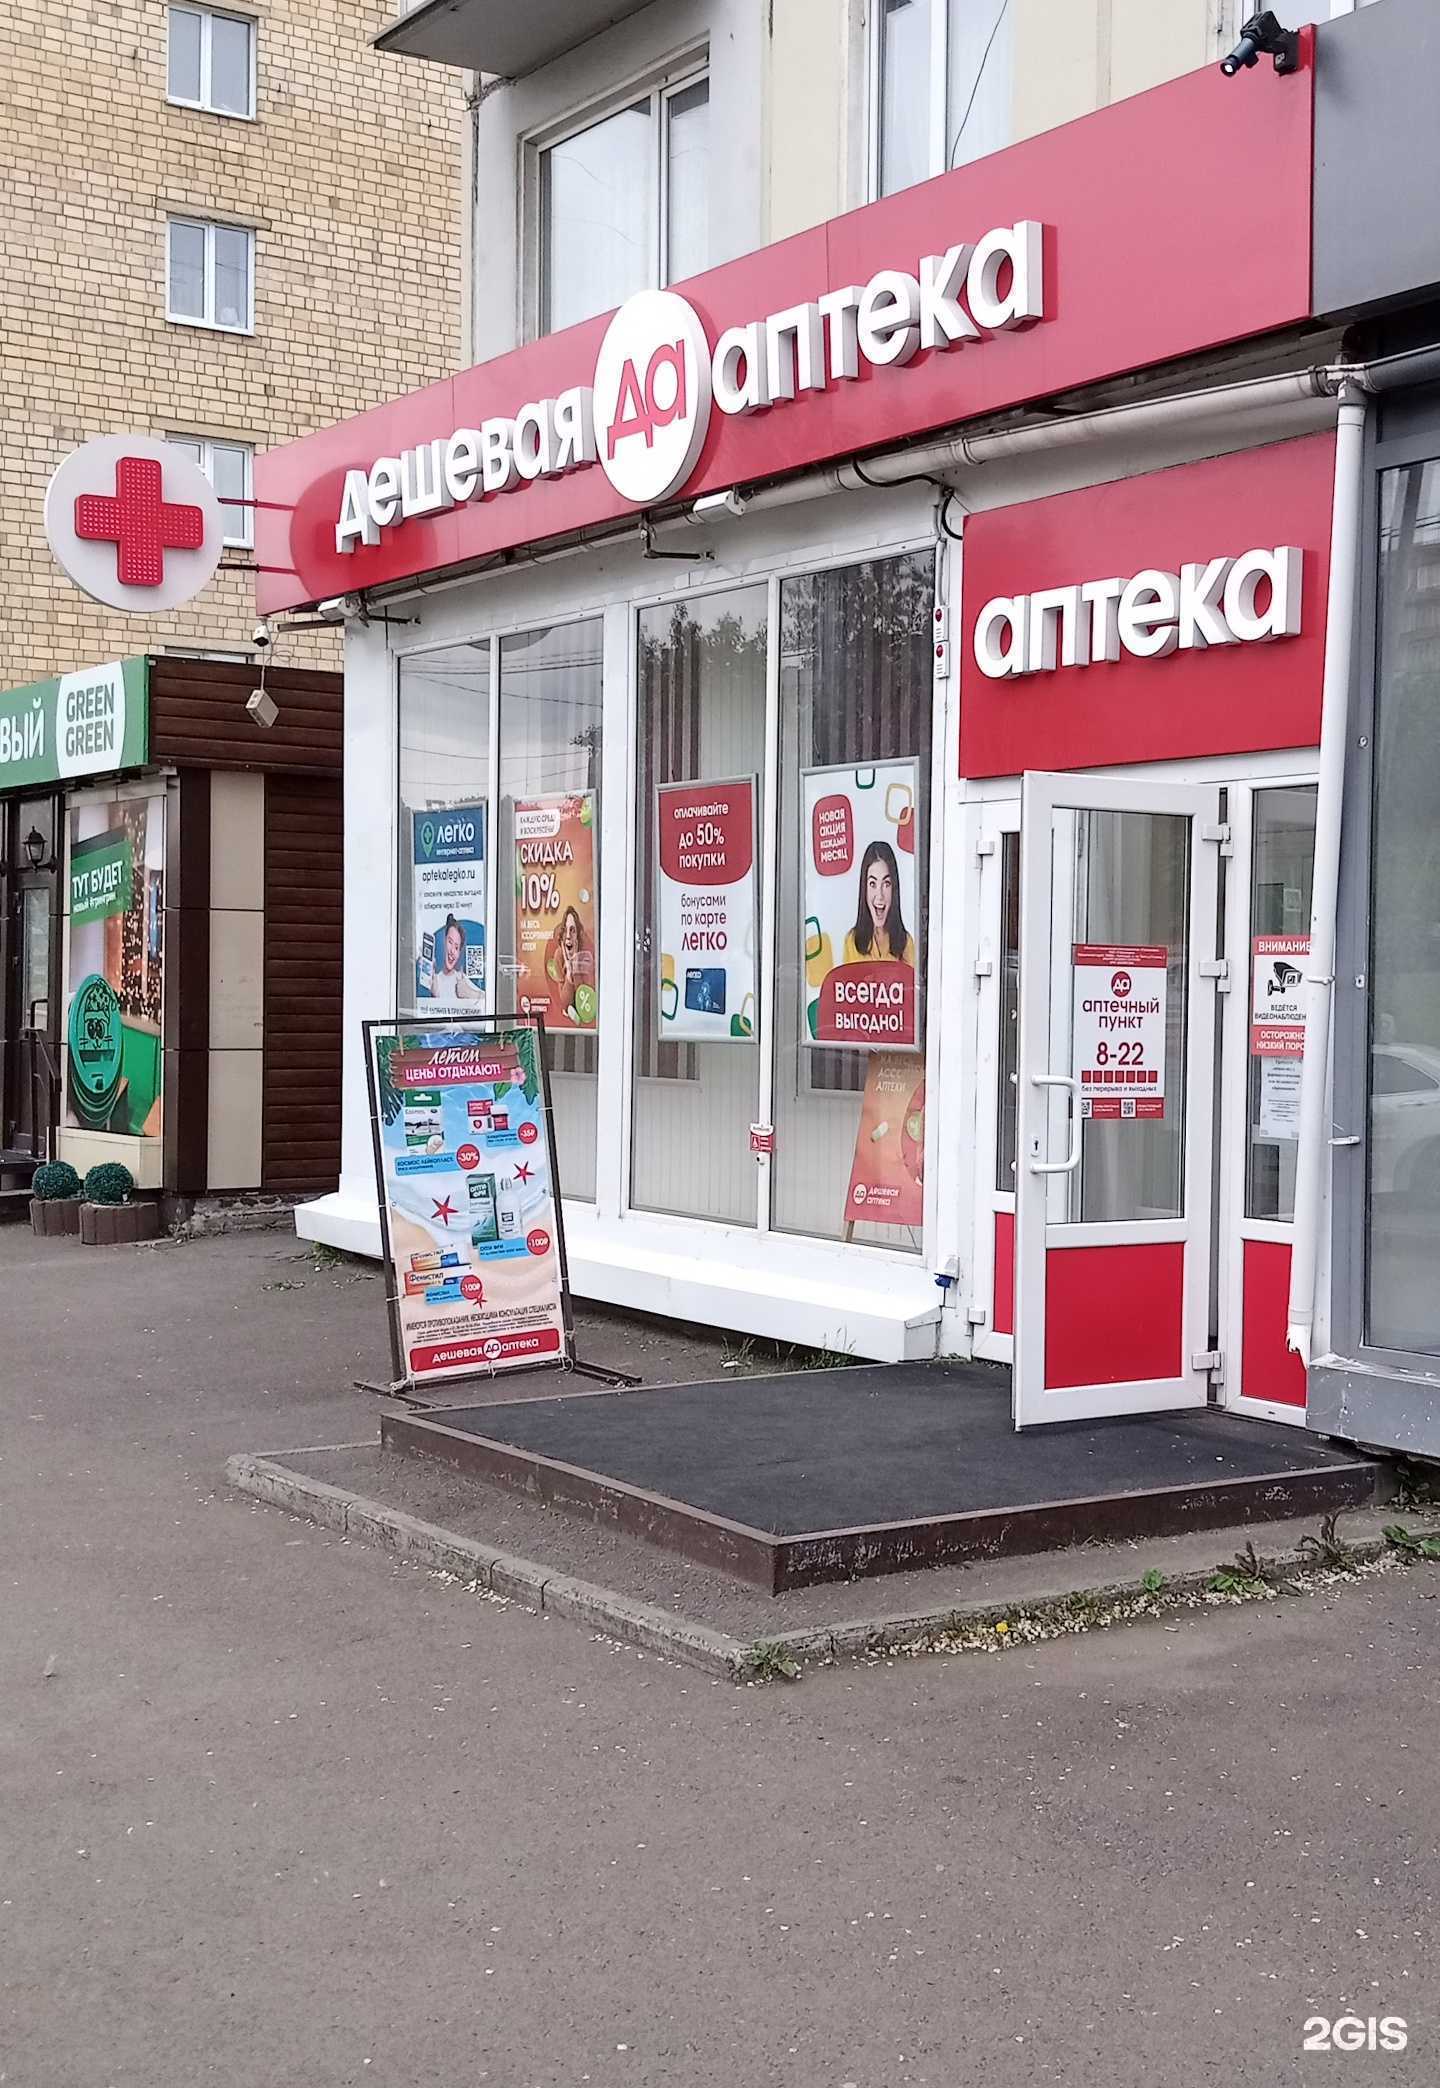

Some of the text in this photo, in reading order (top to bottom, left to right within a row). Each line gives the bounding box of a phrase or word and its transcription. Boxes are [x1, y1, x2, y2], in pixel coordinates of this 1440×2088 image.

[335, 386, 597, 553] дешевая
[712, 220, 1044, 415] аптека
[974, 545, 1303, 679] аптека
[66, 682, 114, 722] GREEN
[65, 718, 114, 757] GREEN
[674, 802, 728, 819] оплачивайте
[819, 808, 845, 824] новая
[679, 822, 725, 849] до 50%
[820, 822, 846, 836] акция
[521, 840, 573, 866] СКИДКА
[679, 852, 726, 870] покупки
[821, 848, 848, 862] месяц
[72, 860, 123, 899] ТУТ БУДЕТ
[422, 868, 476, 883] aptekalegko.ru
[521, 872, 560, 910] 10%
[681, 894, 726, 909] бонусами
[681, 912, 727, 928] по карте
[835, 982, 904, 1008] всегда
[1082, 997, 1159, 1013] аптечный
[835, 1010, 904, 1033] выгодно!
[1099, 1016, 1143, 1031] пункт
[1255, 1012, 1306, 1021] ВИДЕОНАБЛЮДЕН
[1097, 1042, 1144, 1065] 8-22
[1286, 1041, 1305, 1050] ПОРО
[406, 1063, 502, 1081] ЦЕНЫ ОТДЫХАЮТ!
[432, 1347, 484, 1364] дешевая
[502, 1338, 539, 1351] аптека
